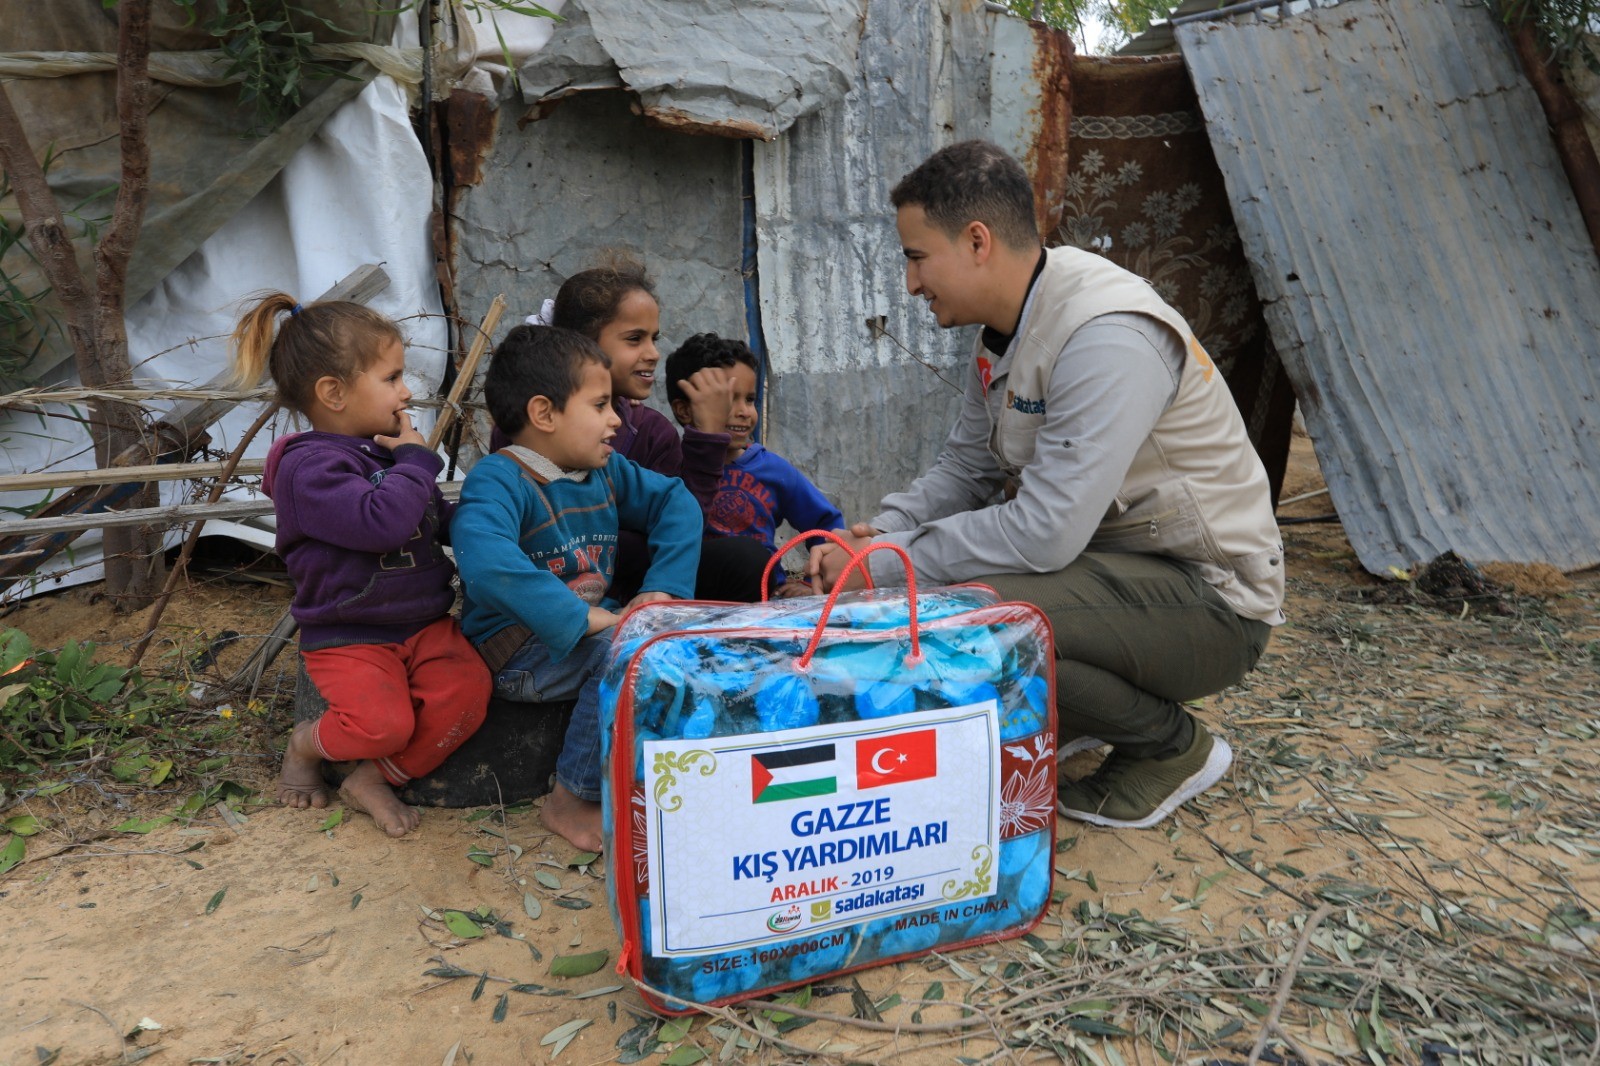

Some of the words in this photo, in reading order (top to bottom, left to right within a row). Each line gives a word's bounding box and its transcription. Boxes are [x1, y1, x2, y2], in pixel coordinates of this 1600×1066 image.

[790, 797, 891, 838] GAZZE
[733, 850, 779, 883] KIŞ
[782, 820, 948, 873] YARDIMLARI
[770, 876, 839, 903] ARALIK
[851, 866, 894, 887] 2019
[835, 883, 925, 914] sadakataşı
[895, 911, 940, 931] MADE
[944, 908, 959, 922] IN
[963, 899, 1009, 917] CHINA
[702, 933, 845, 975] SIZE:160X200CM
